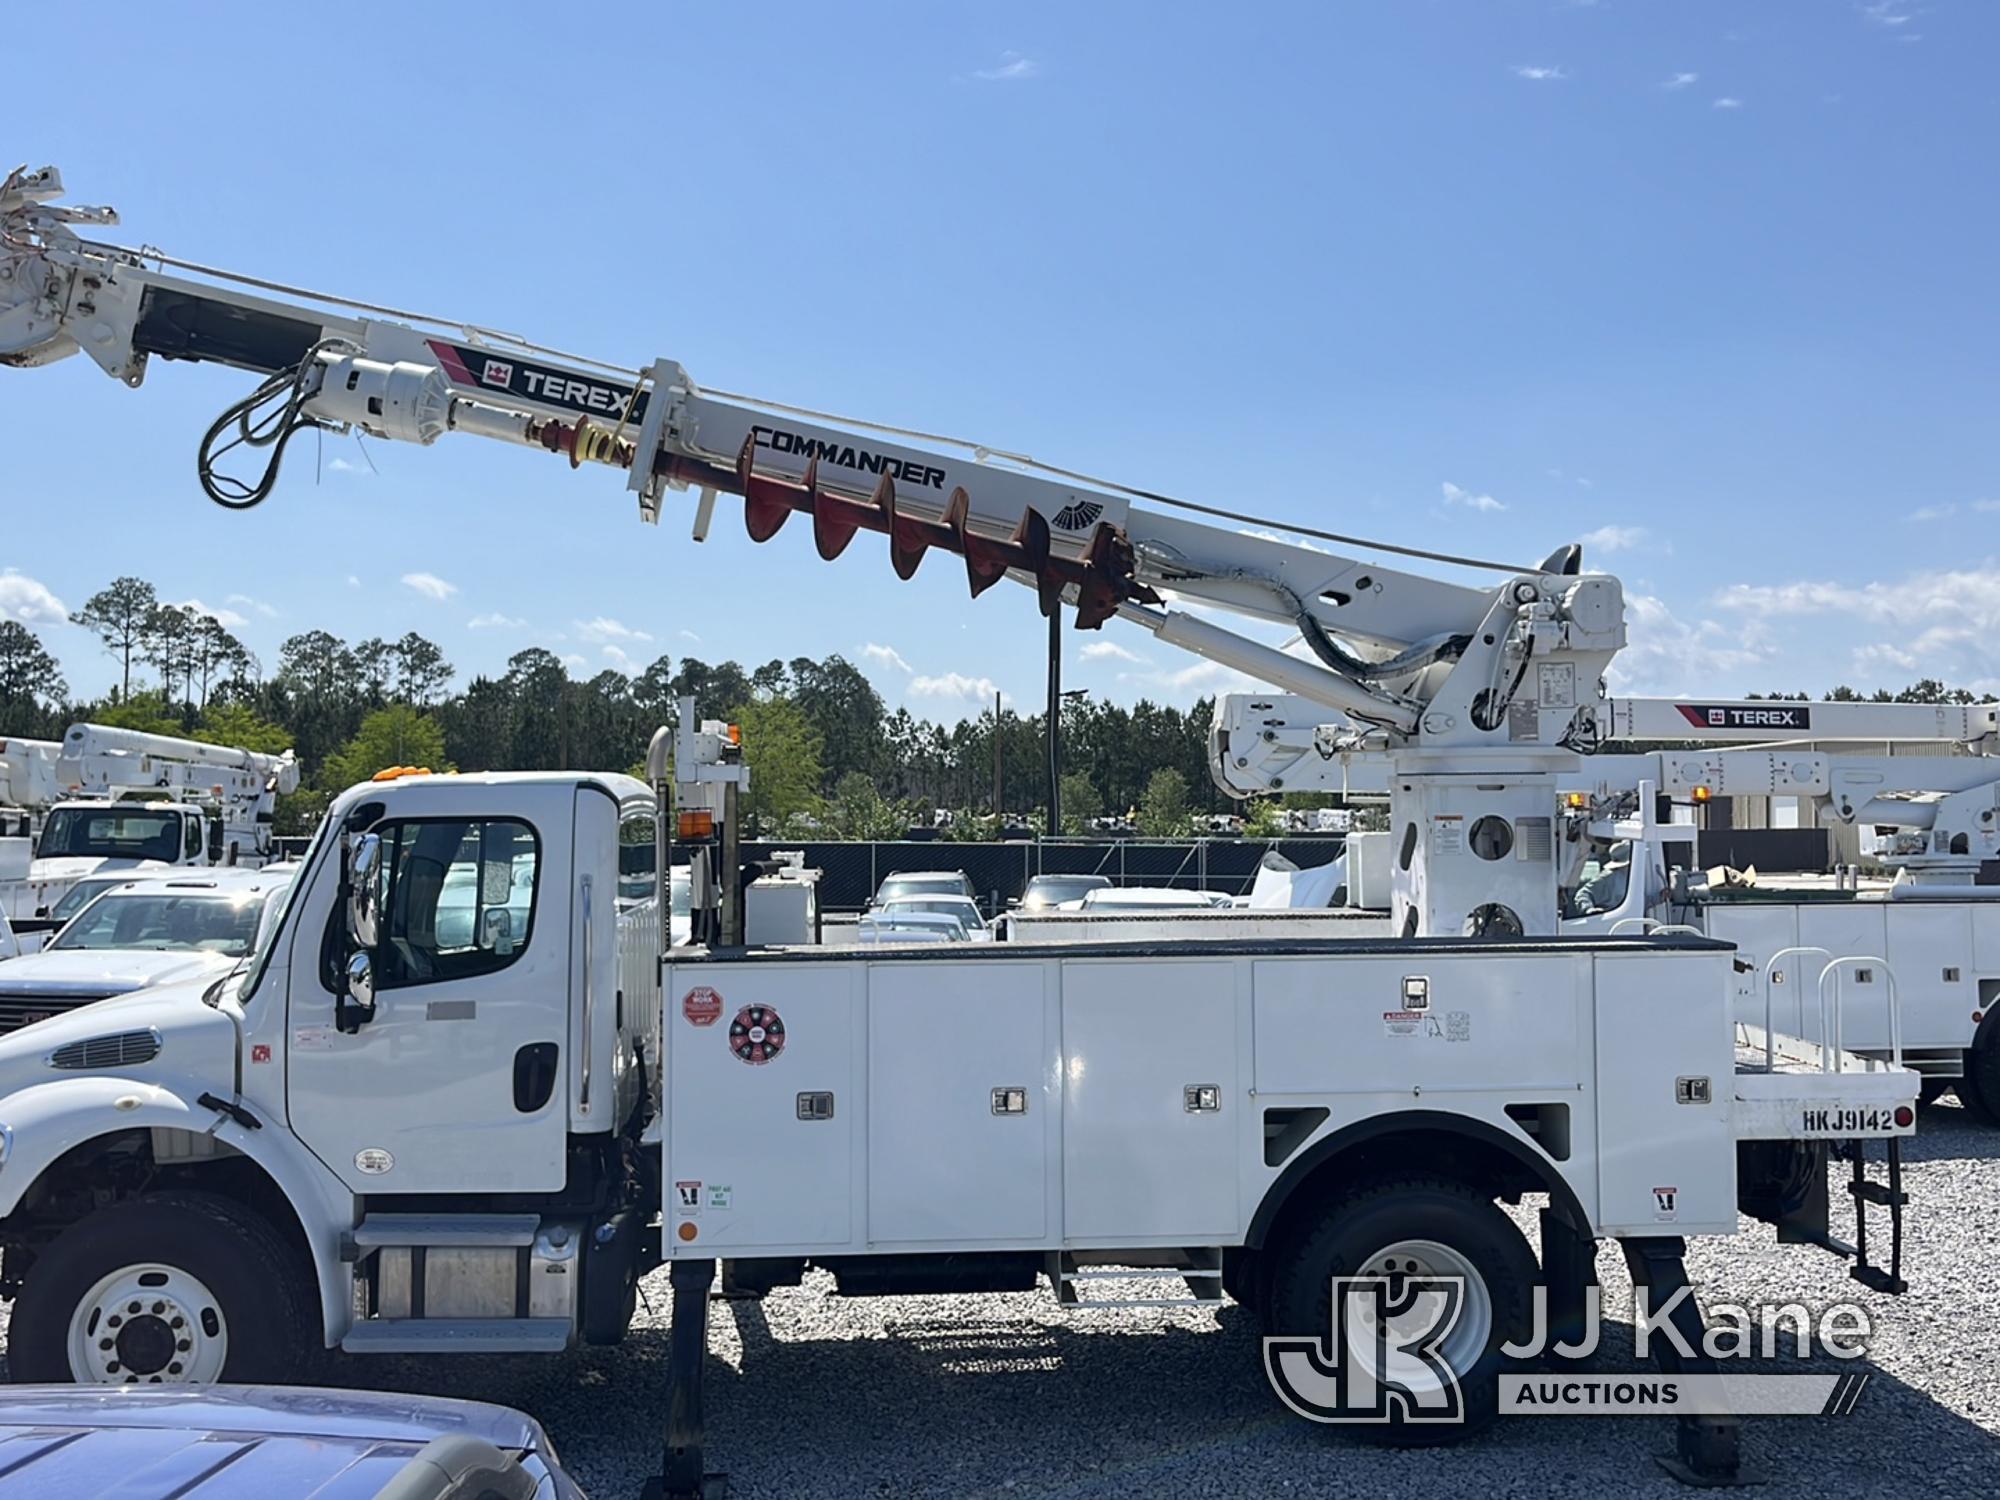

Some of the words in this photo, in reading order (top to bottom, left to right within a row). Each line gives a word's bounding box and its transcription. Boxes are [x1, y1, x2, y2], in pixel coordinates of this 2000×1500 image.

[523, 370, 633, 415] TEREX
[751, 425, 946, 489] COMMANDER
[1730, 710, 1795, 725] TEREX
[1803, 1110, 1892, 1131] HKJ9142
